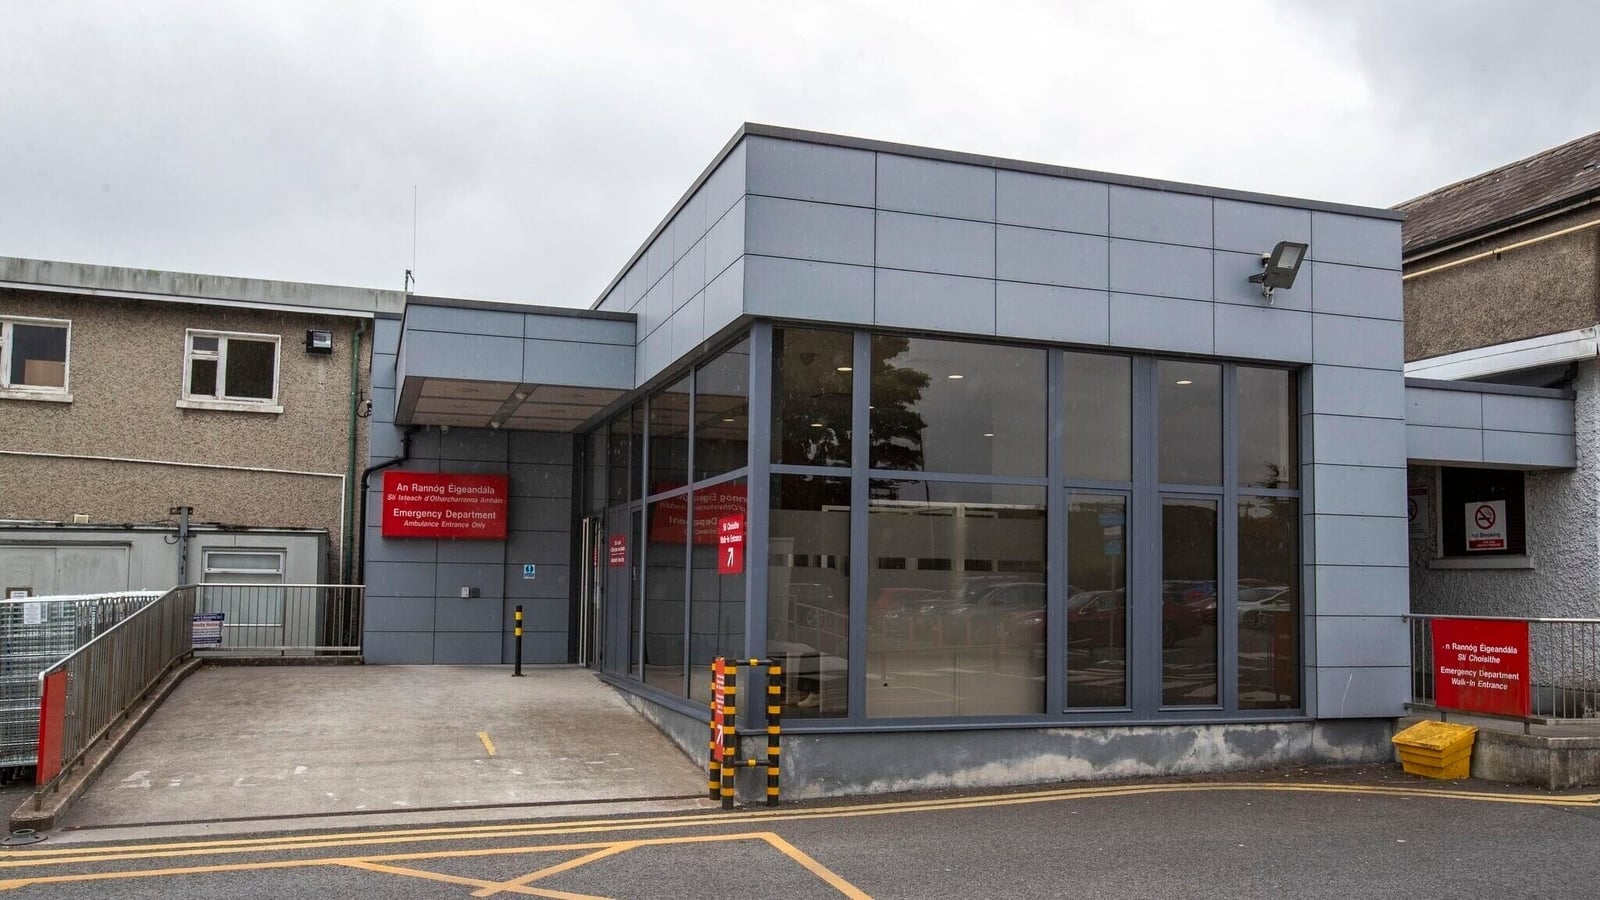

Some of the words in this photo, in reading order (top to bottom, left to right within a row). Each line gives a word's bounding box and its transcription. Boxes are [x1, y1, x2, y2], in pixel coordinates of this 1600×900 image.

[397, 483, 408, 491] An
[412, 483, 445, 494] Rannóg
[448, 482, 495, 495] Éigeandála
[398, 494, 422, 502] Isteach
[393, 508, 442, 519] Emergency
[445, 509, 496, 519] Department
[403, 520, 439, 528] Ambulance
[441, 521, 469, 529] Entrance
[471, 521, 486, 529] Only
[1452, 642, 1478, 653] Rannóg
[1480, 641, 1518, 655] Éigeandála
[1468, 654, 1501, 664] Choisithe
[1440, 666, 1477, 678] Emergency
[1479, 669, 1520, 681] Department
[1477, 680, 1508, 690] Entrance
